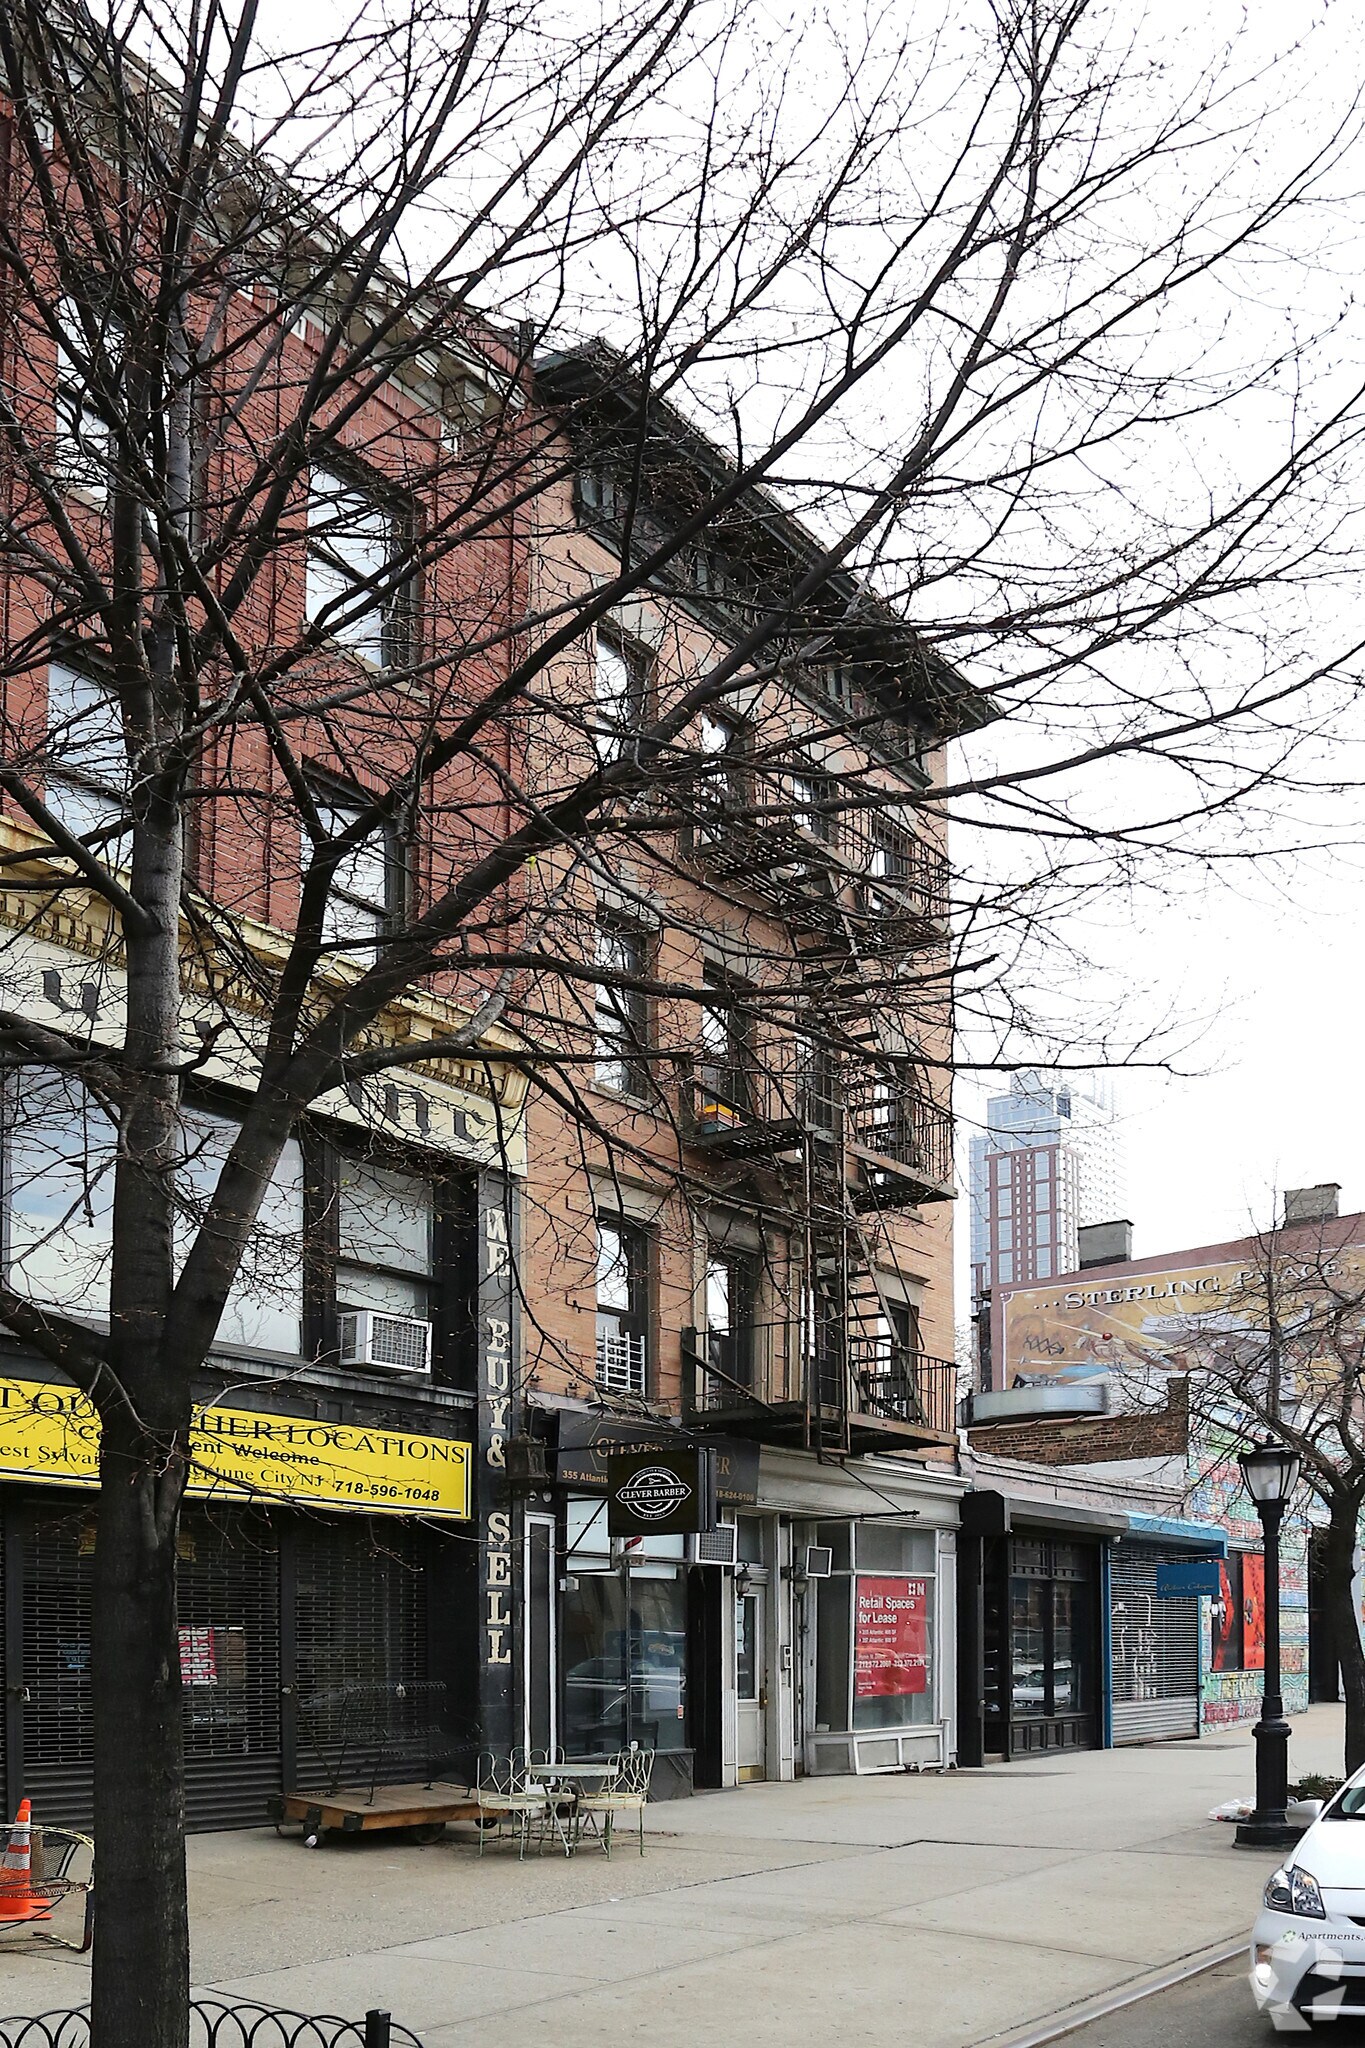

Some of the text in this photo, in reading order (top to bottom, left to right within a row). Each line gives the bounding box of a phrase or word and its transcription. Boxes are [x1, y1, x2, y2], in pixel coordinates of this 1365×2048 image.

[33, 1391, 97, 1419] OU
[198, 1412, 276, 1440] HER
[287, 1425, 465, 1465] LOCATIONS
[233, 1443, 320, 1466] Welcome
[0, 1445, 440, 1501] est Sylva eptune City NJ 718-596-1048
[562, 1470, 609, 1483] 355 Atlanti
[620, 1487, 686, 1500] CLEVER BARBER
[716, 1490, 754, 1501] 18-624-0100
[486, 1512, 512, 1664] SELL
[859, 1596, 915, 1611] Retail Spaces
[858, 1611, 898, 1624] for Lease
[1298, 1931, 1365, 1942] Apartments.
